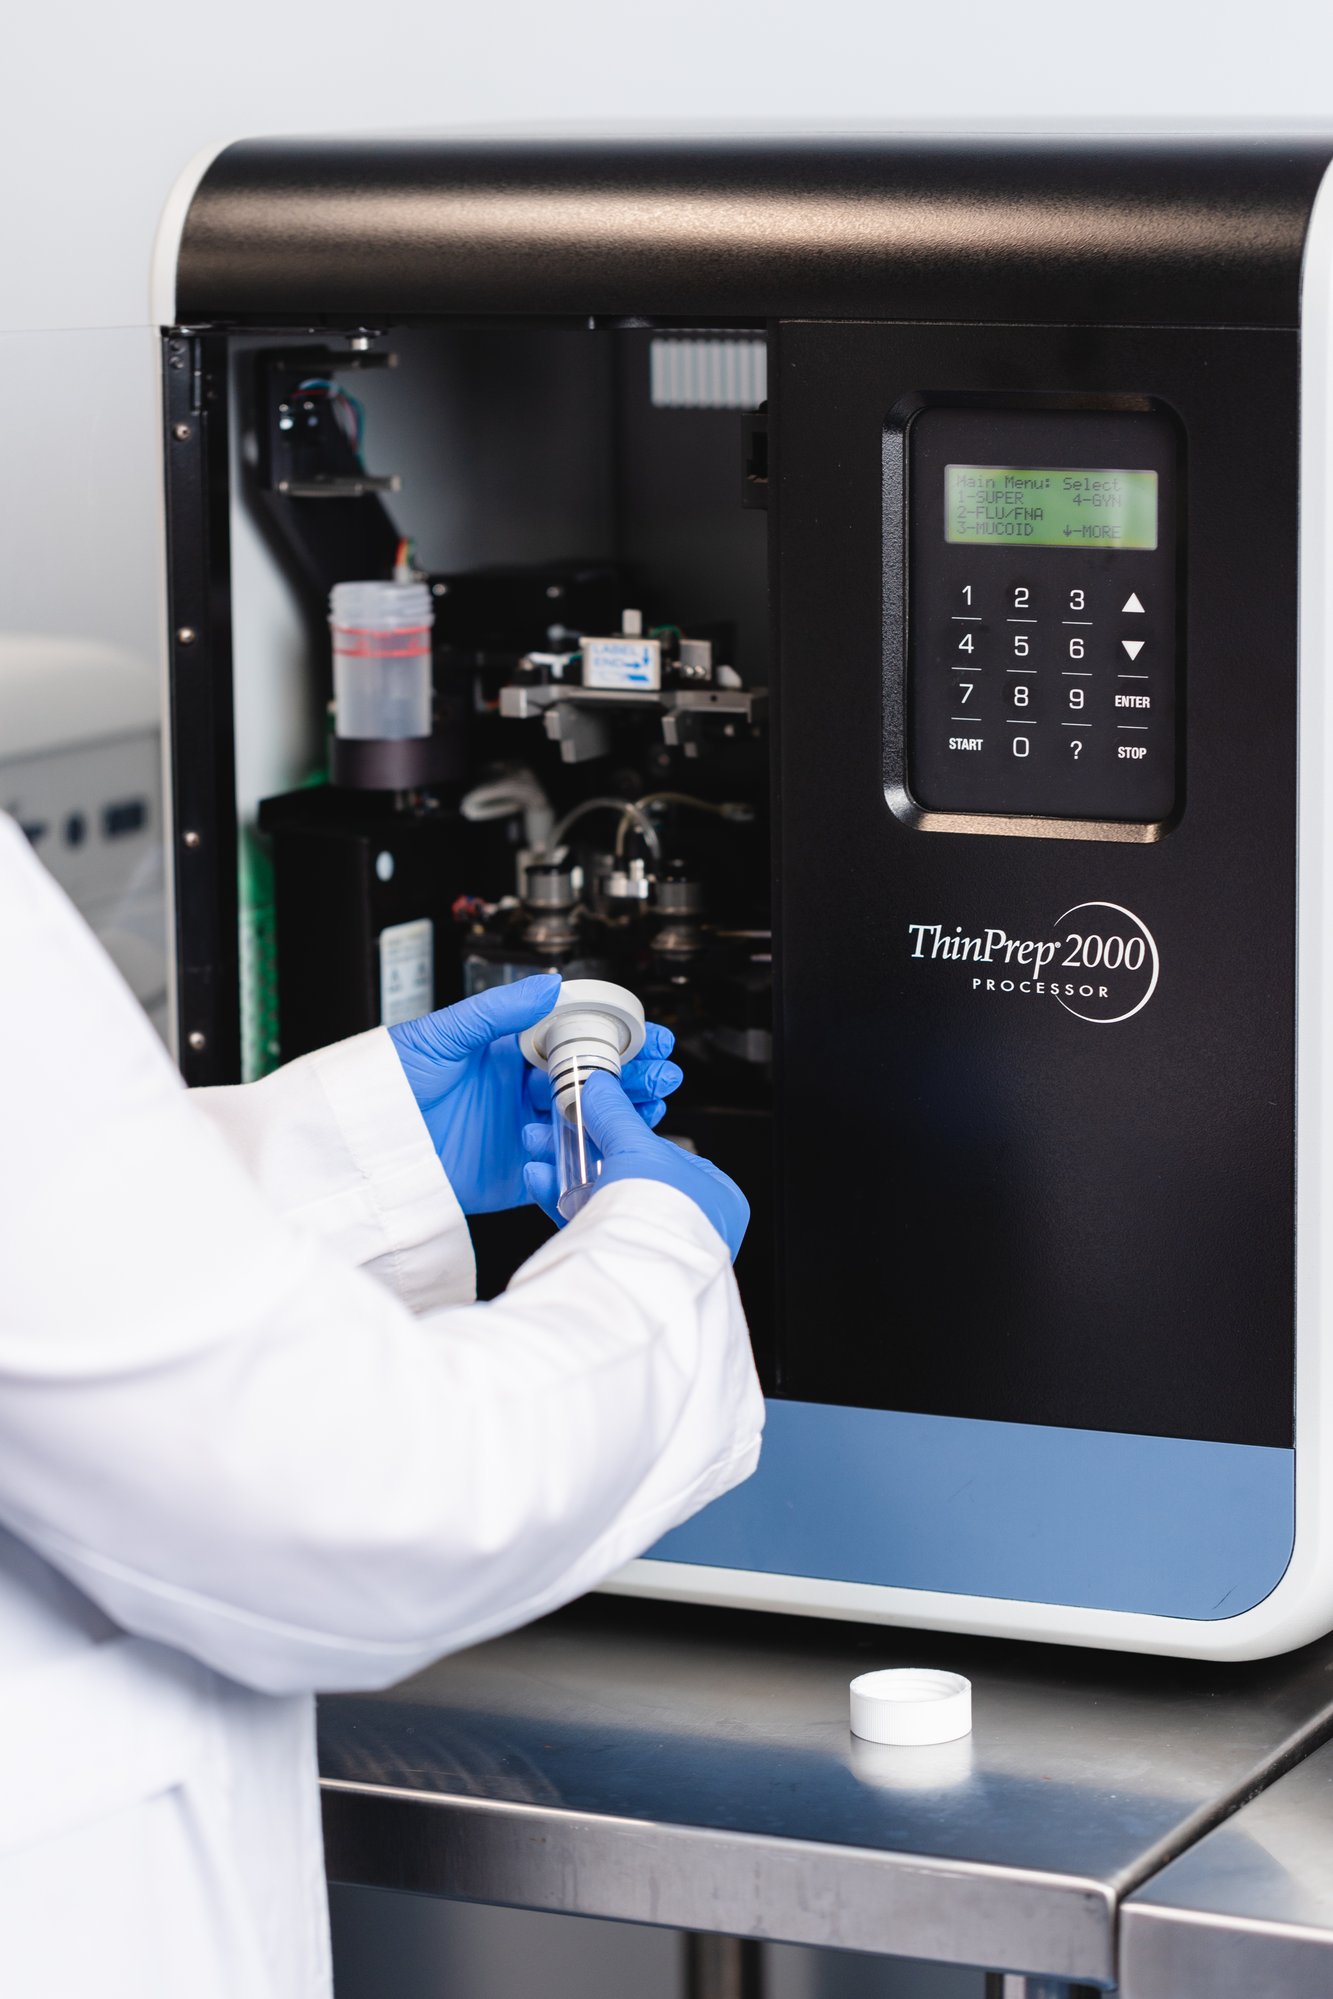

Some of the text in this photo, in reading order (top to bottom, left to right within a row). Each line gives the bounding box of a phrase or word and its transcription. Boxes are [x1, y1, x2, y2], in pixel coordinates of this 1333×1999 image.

[956, 474, 1122, 492] Main Menu: Select
[957, 491, 1122, 508] 1-SUPER 4-GYN
[956, 506, 1044, 521] 2-FLU/FNA
[956, 521, 1034, 537] 3-MUCOID
[962, 585, 1085, 611] 1 2 3
[958, 633, 1085, 659] 4 5 6
[959, 683, 1151, 710] 7 8 9 ENTER
[949, 737, 984, 751] START
[1012, 736, 1030, 758] 0
[1117, 746, 1148, 759] STOP
[1061, 933, 1146, 971] 2000
[972, 977, 1109, 998] PROCESSOR
